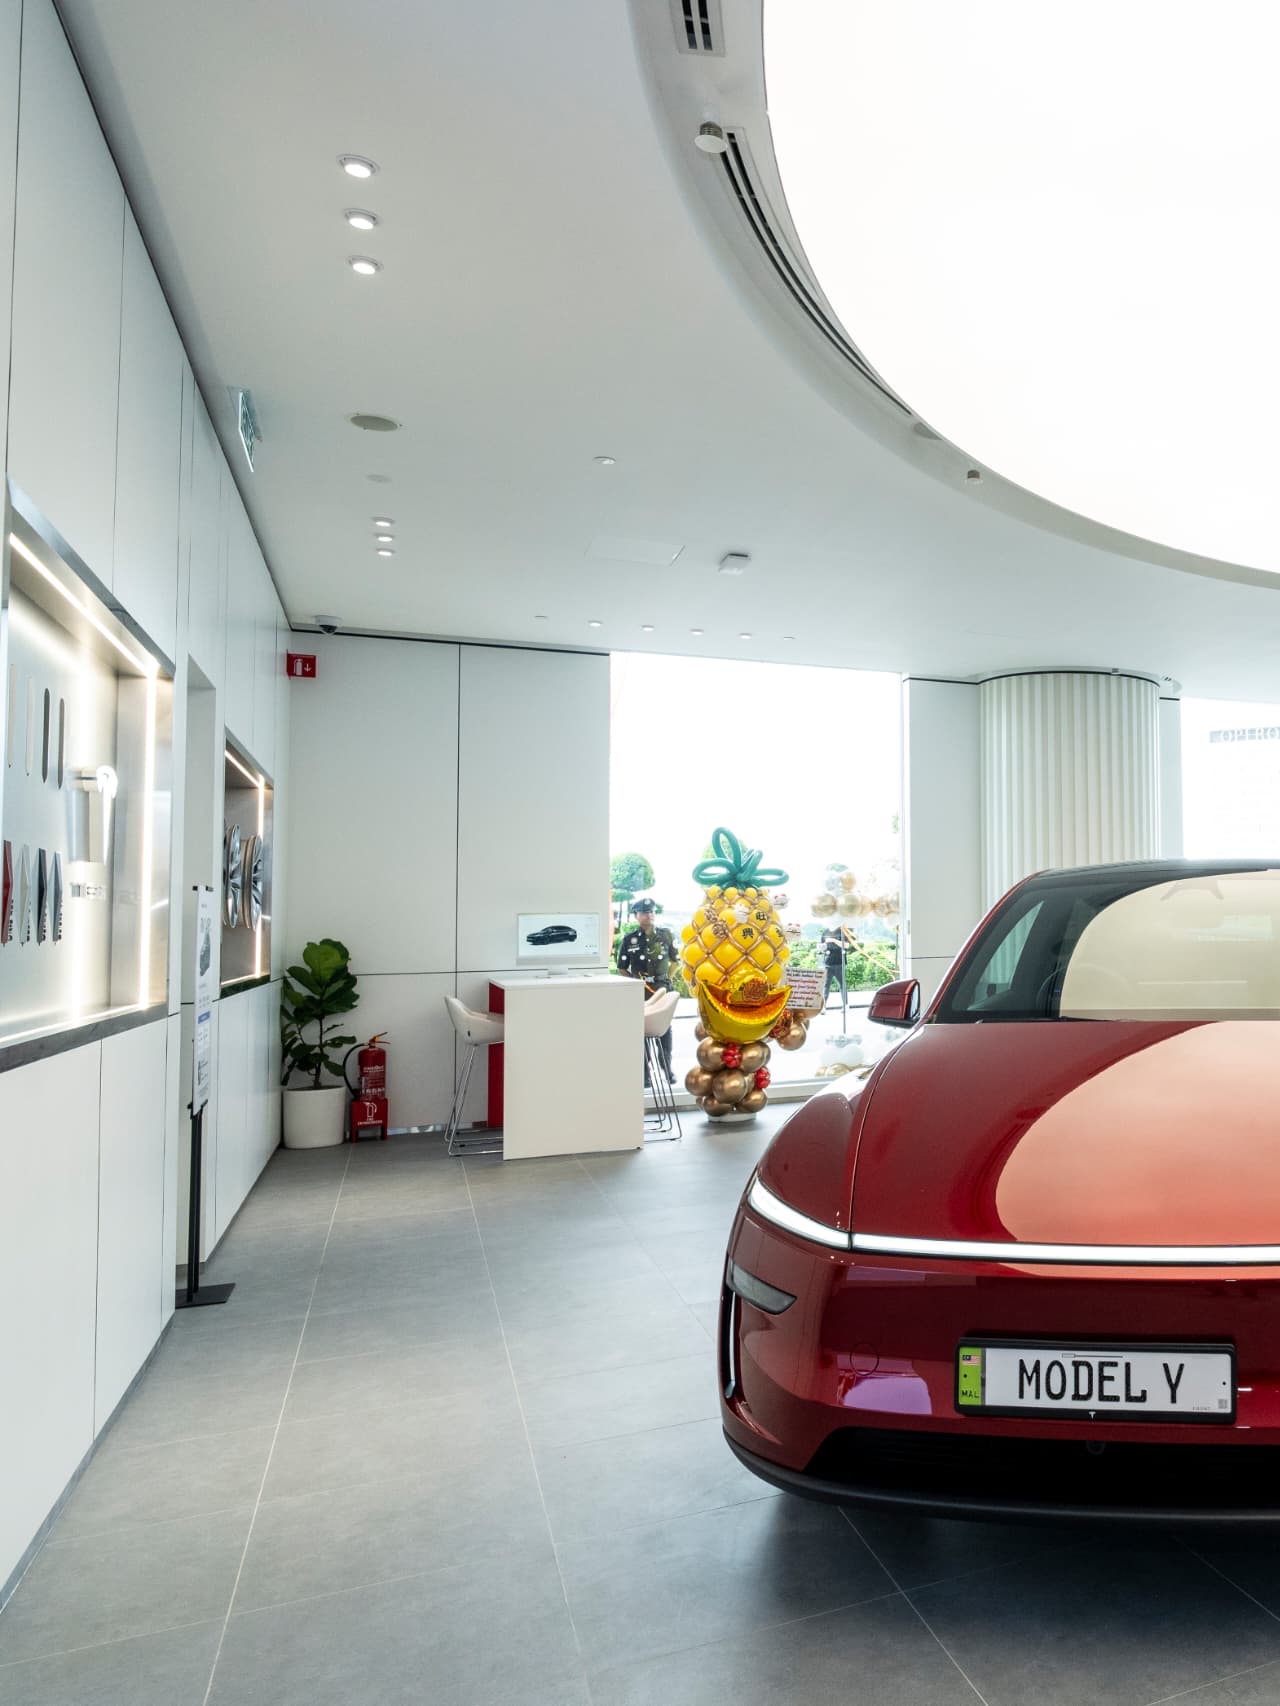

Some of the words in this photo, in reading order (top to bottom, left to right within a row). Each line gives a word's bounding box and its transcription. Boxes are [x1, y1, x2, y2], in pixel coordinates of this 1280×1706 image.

[962, 1390, 980, 1399] MAL
[1018, 1359, 1147, 1403] MODEL
[1163, 1363, 1185, 1404] Y
